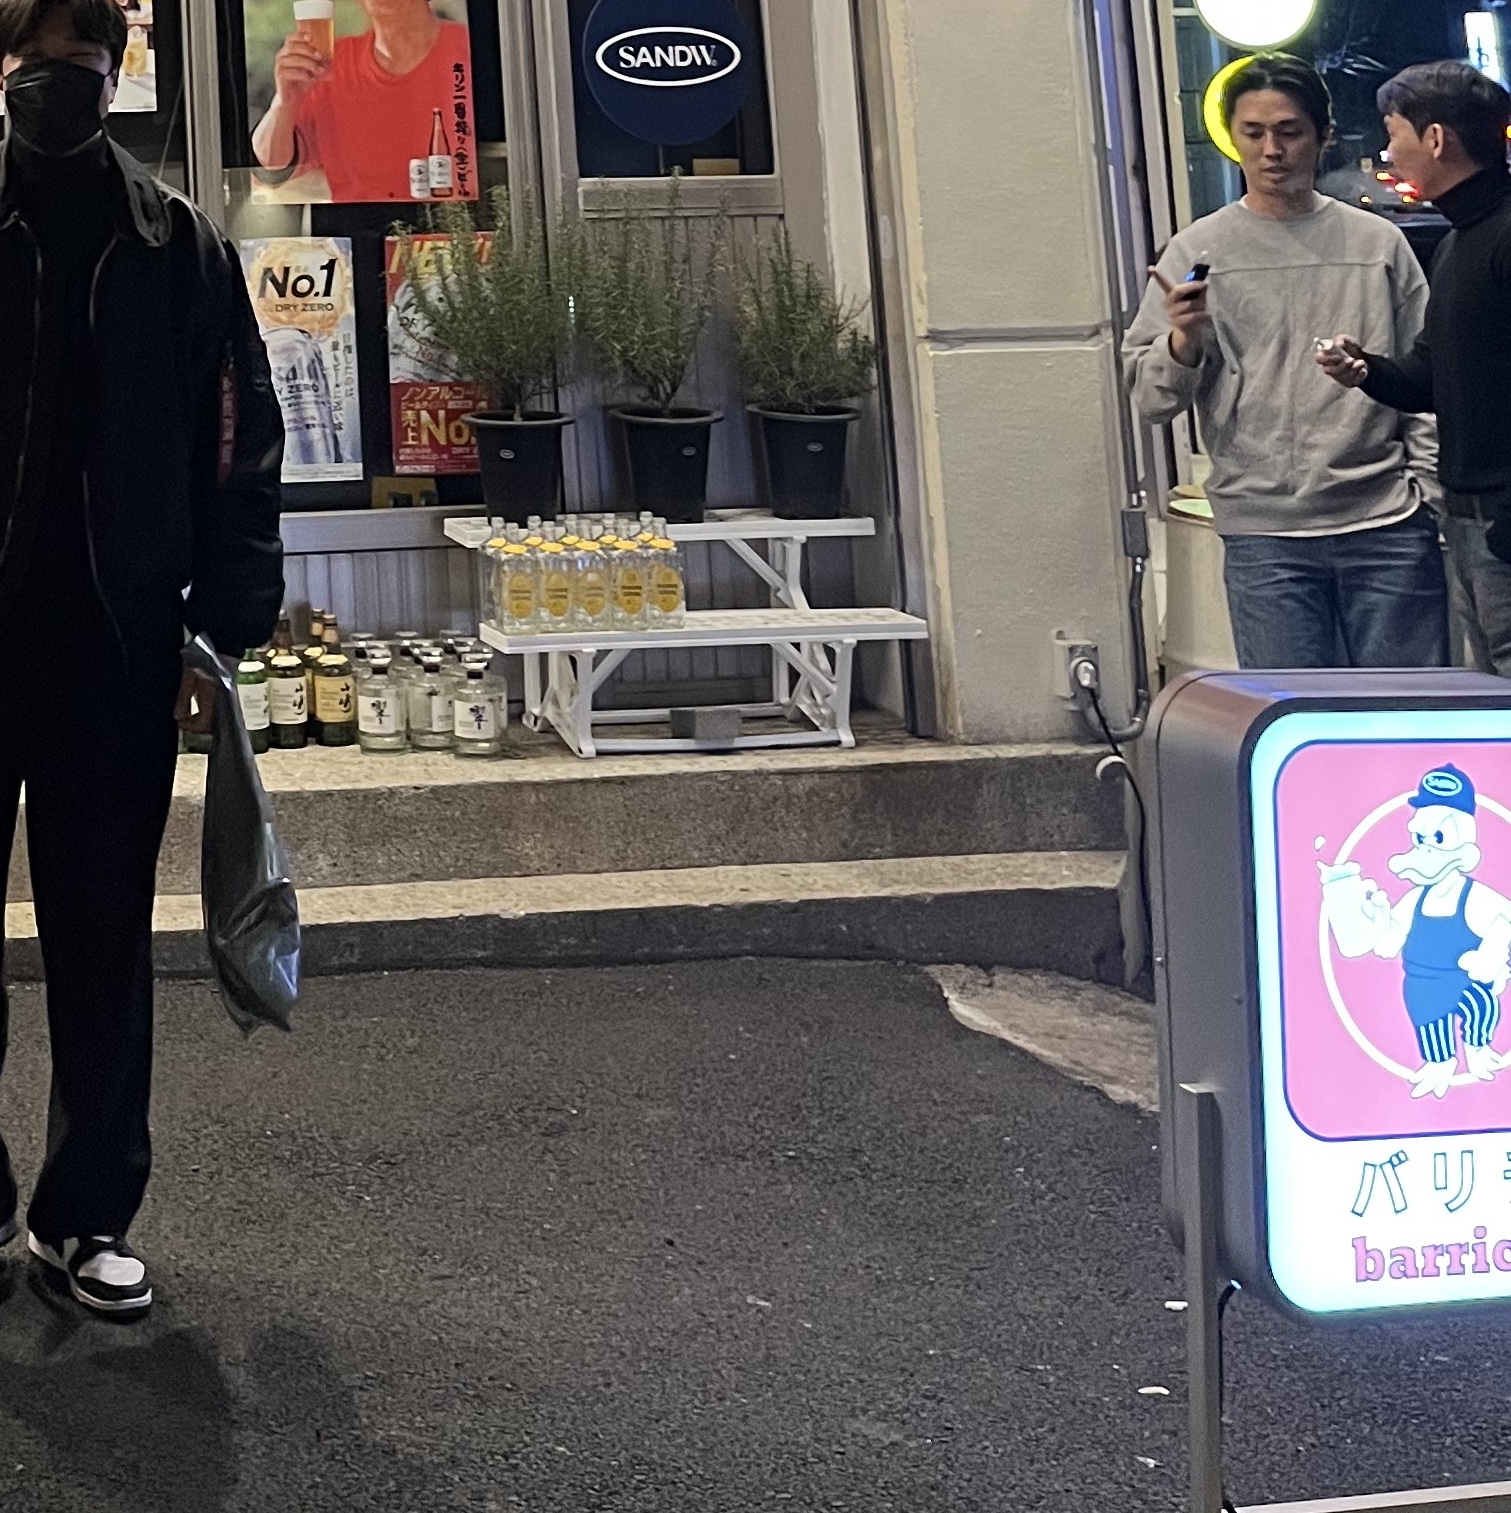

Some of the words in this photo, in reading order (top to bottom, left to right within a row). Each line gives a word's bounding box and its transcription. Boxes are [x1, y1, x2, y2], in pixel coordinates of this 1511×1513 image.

[257, 258, 338, 300] No.1
[275, 303, 299, 313] DRY
[301, 302, 334, 312] ZERO
[401, 410, 419, 445] 売上
[1350, 1149, 1511, 1218] バリ
